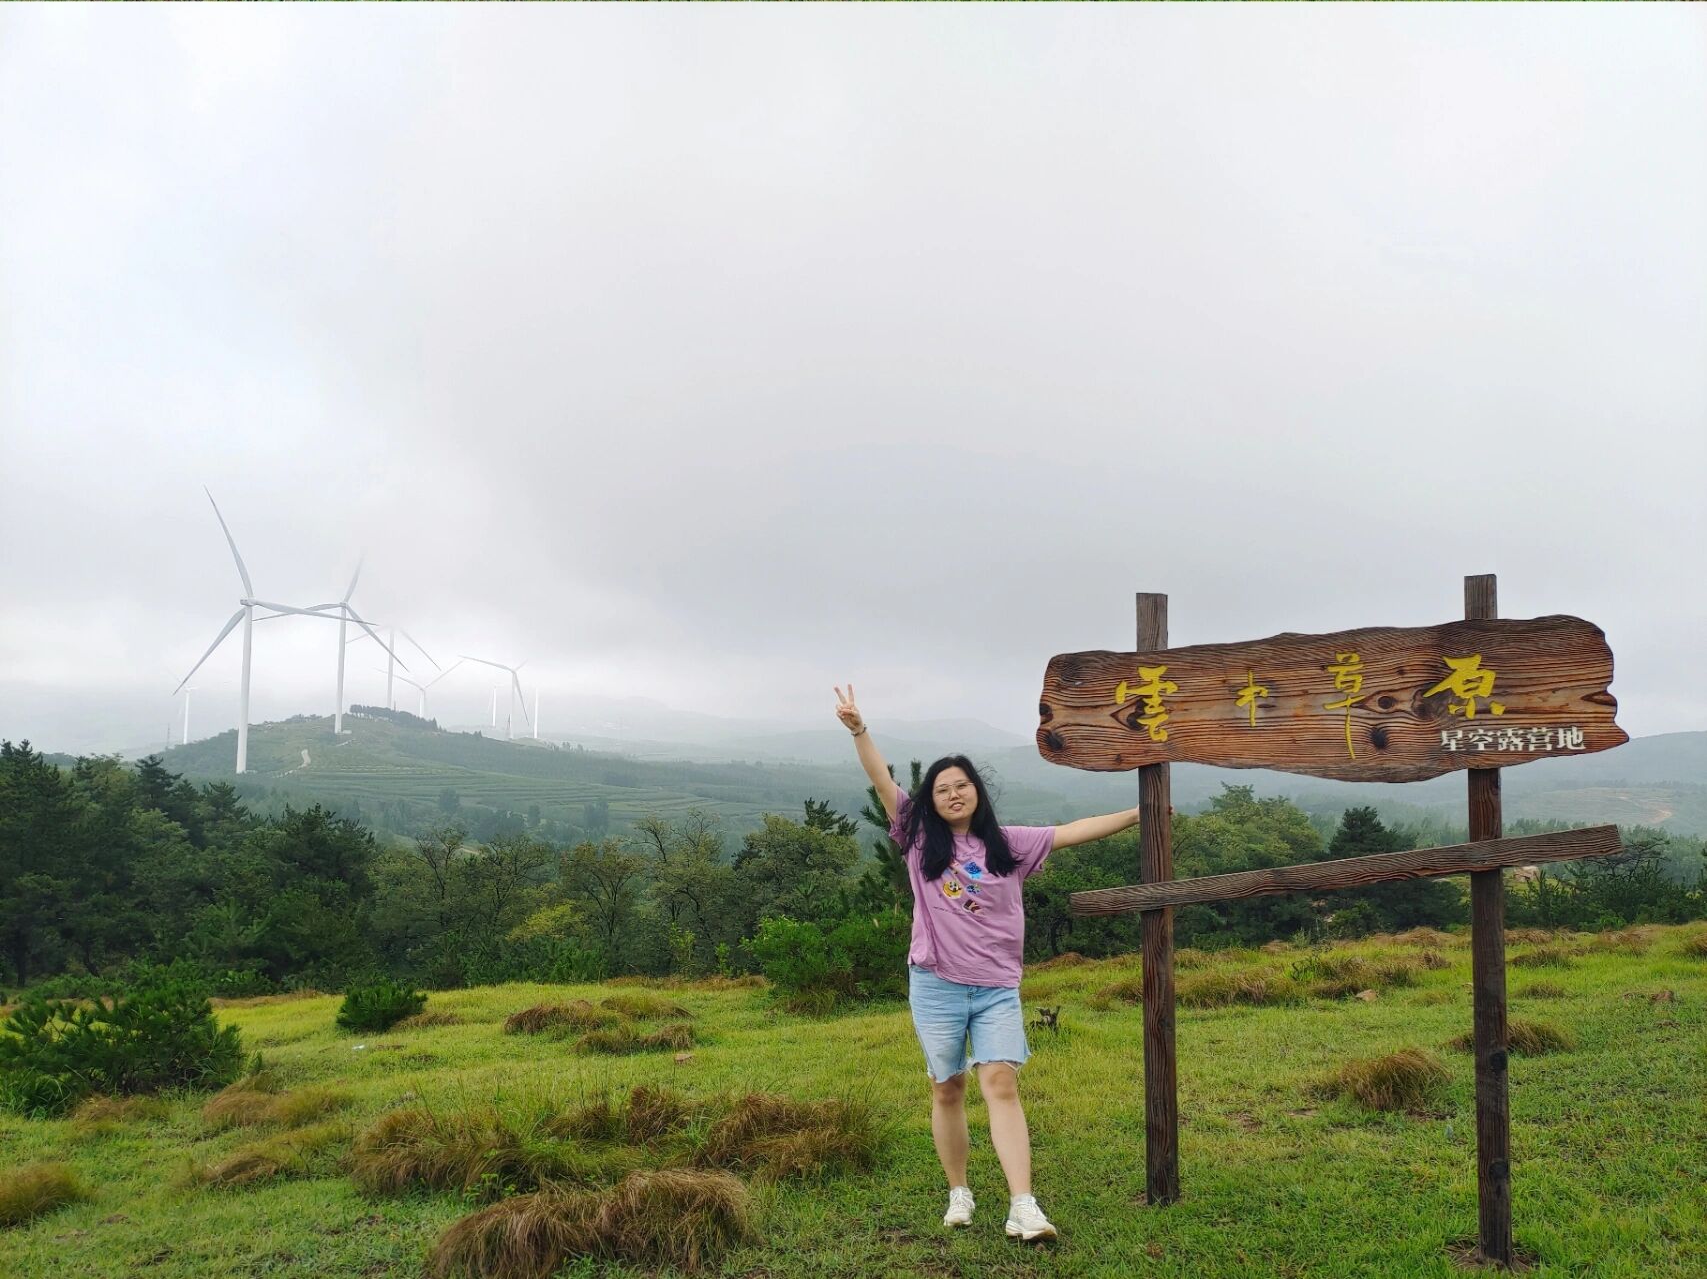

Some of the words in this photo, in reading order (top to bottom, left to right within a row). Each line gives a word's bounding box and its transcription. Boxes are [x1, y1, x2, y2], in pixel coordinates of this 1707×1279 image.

[1440, 726, 1585, 751] 星空露营地
